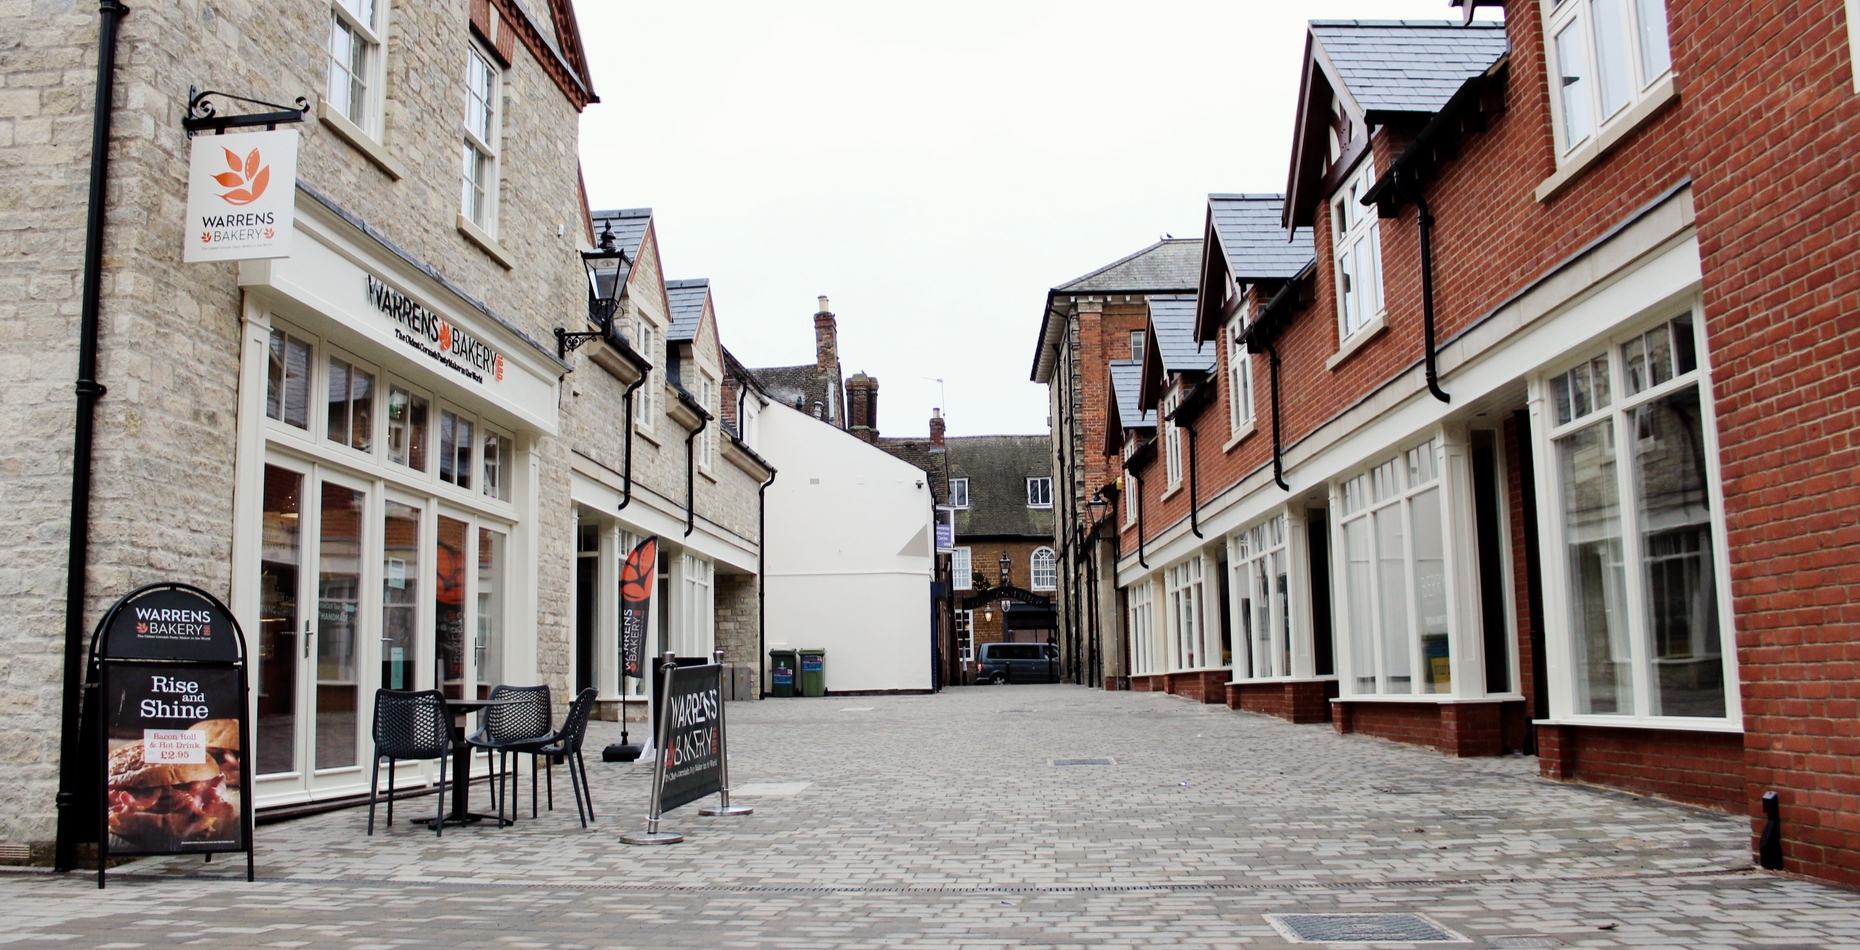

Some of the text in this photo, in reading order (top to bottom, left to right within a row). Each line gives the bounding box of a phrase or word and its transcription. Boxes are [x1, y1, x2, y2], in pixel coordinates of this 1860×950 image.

[202, 212, 275, 228] WARRENS
[214, 228, 263, 242] BAKERY
[367, 274, 439, 343] WARRENS
[452, 327, 498, 376] BAKERY
[395, 328, 406, 342] The
[136, 607, 211, 623] WARRENS
[150, 622, 203, 635] BAKERY
[624, 608, 633, 670] WRRENS
[629, 616, 641, 662] BAKERY
[151, 675, 198, 693] Rise
[182, 692, 205, 702] and
[141, 699, 209, 719] Shine
[153, 733, 196, 741] Bacon Roll
[161, 750, 189, 760] £2.95
